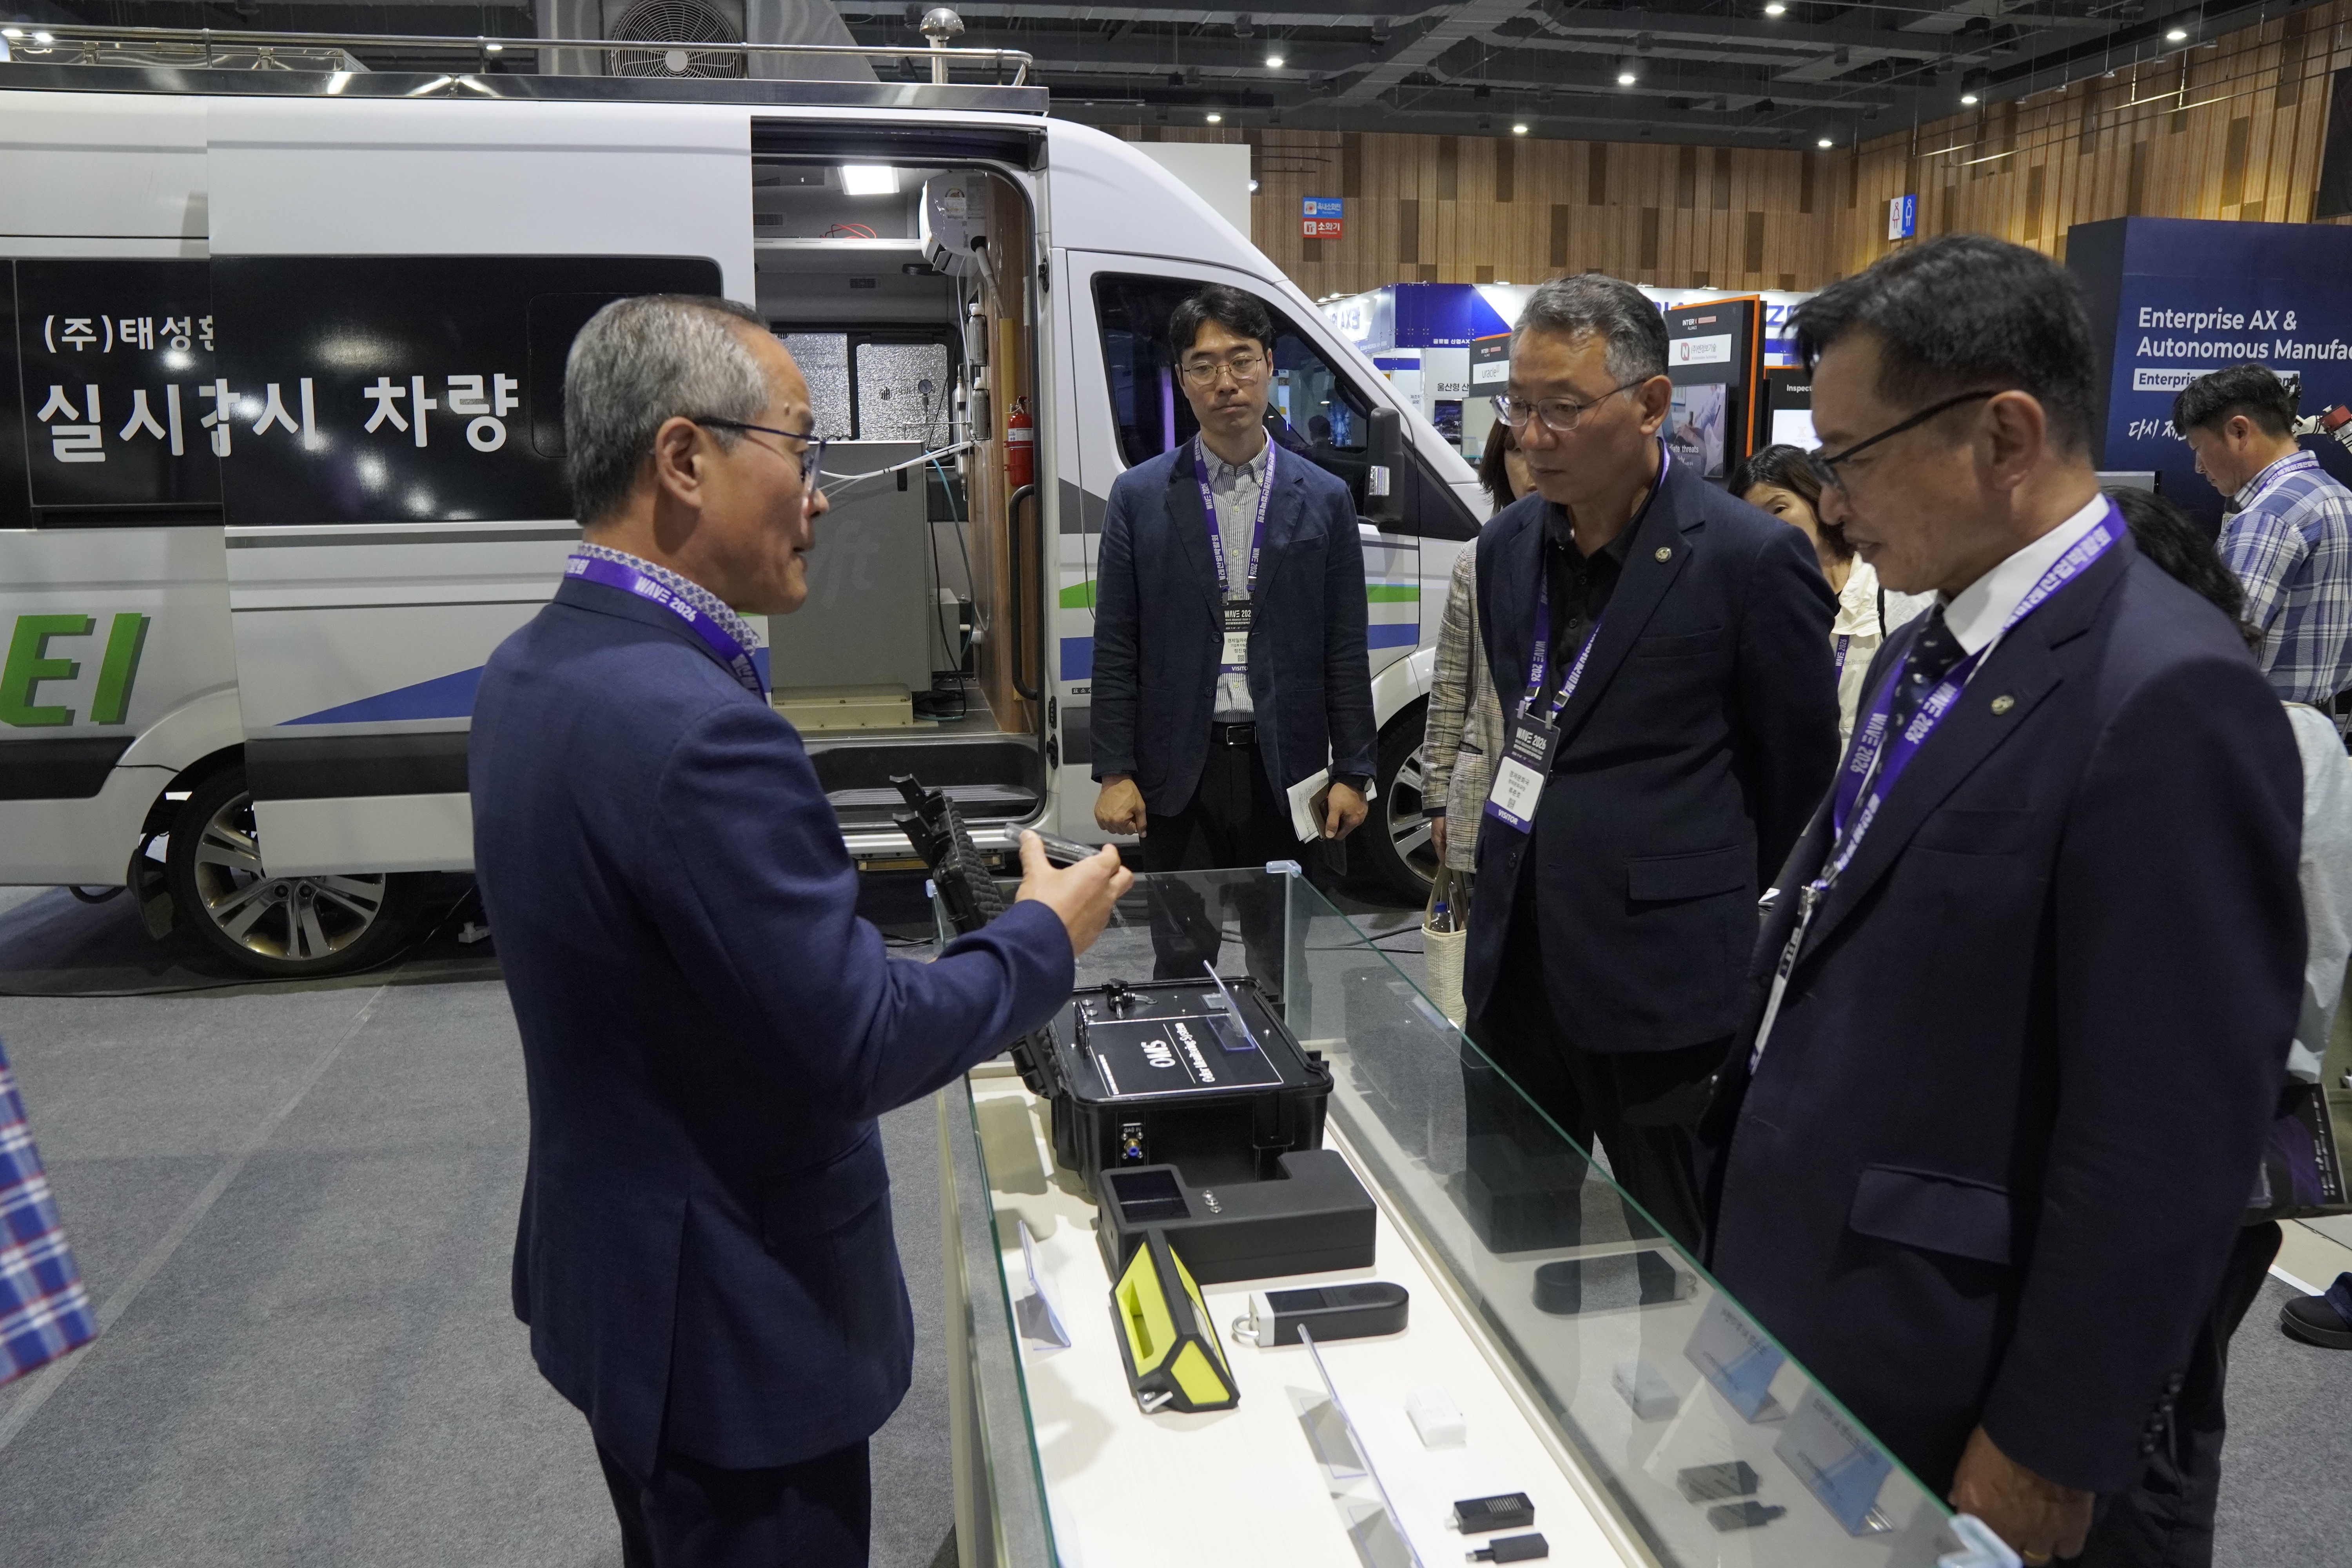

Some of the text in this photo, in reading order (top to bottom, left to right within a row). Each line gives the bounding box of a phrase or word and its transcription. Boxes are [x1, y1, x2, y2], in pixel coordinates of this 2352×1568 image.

[1318, 222, 1340, 231] 소화기
[2139, 307, 2298, 334] Enterprise AX &
[2136, 336, 2269, 359] Autonomous
[1437, 383, 1459, 391] 울산형
[2139, 373, 2196, 388] Enterpris
[363, 373, 519, 452] 차량
[2128, 418, 2159, 441] 다시
[1682, 445, 1699, 453] threats
[1252, 548, 1260, 564] WAVE
[634, 576, 697, 622] WAVE 2026
[1225, 610, 1240, 618] WAVE
[1531, 641, 1546, 682] WAVE 2026
[1835, 639, 1847, 666] WAVE 2026
[1904, 682, 1957, 745] WAVE 2026
[1516, 726, 1533, 744] WAVE
[1533, 735, 1547, 751] 2026
[1864, 713, 1888, 750] WAVE
[1849, 742, 1876, 776] 2026
[1498, 809, 1519, 826] VISITOR
[1140, 1040, 1176, 1068] OMS
